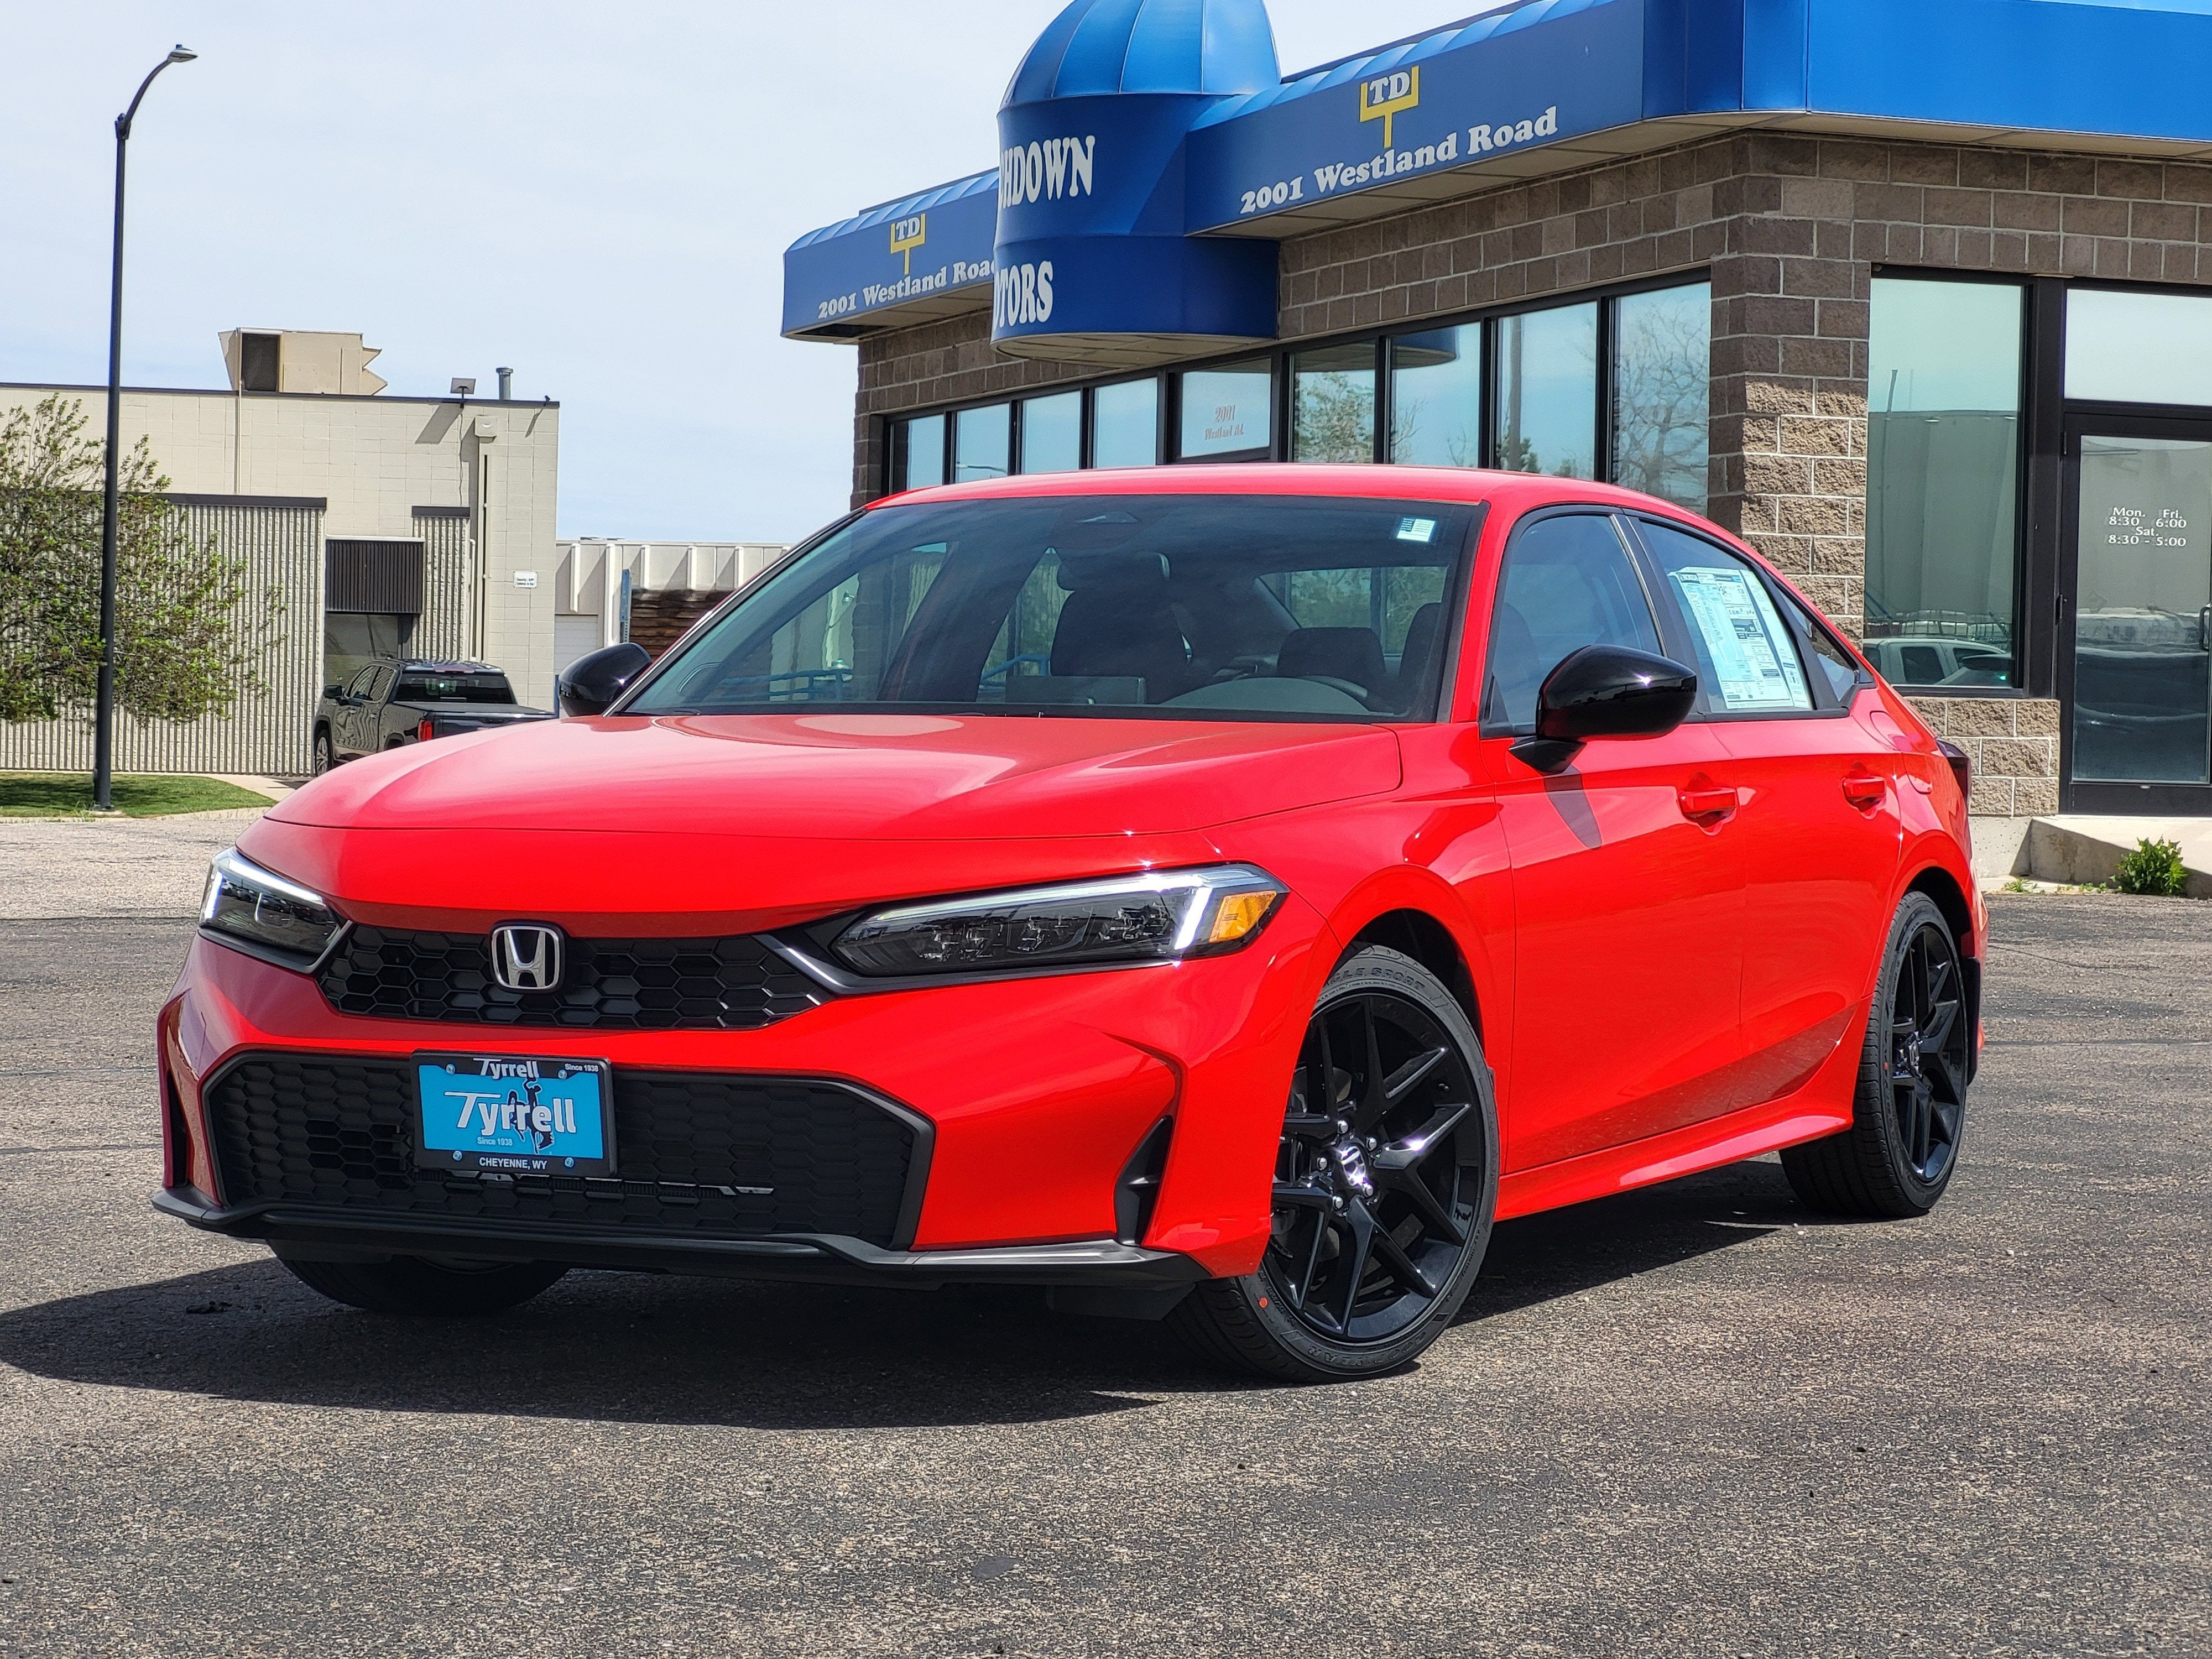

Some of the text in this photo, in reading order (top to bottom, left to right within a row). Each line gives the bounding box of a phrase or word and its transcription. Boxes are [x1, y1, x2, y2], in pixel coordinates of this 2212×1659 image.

[1370, 71, 1411, 105] TD
[1240, 105, 1558, 215] 2001 Westland Road
[896, 217, 921, 241] TD
[818, 259, 994, 319] 2001 Westland Roa
[2109, 517, 2187, 528] 8:30 6:00
[2112, 507, 2183, 519] Mon. Fri.
[2108, 535, 2140, 544] 8:30
[2156, 537, 2187, 546] 5:00
[2135, 526, 2159, 536] Sat.
[1371, 968, 1426, 990] SPORT
[473, 1058, 540, 1079] Tyrrell
[444, 1091, 577, 1136] Tyrrell
[477, 1137, 513, 1146] Since 1938
[479, 1157, 547, 1170] CHEYENNE, WY
